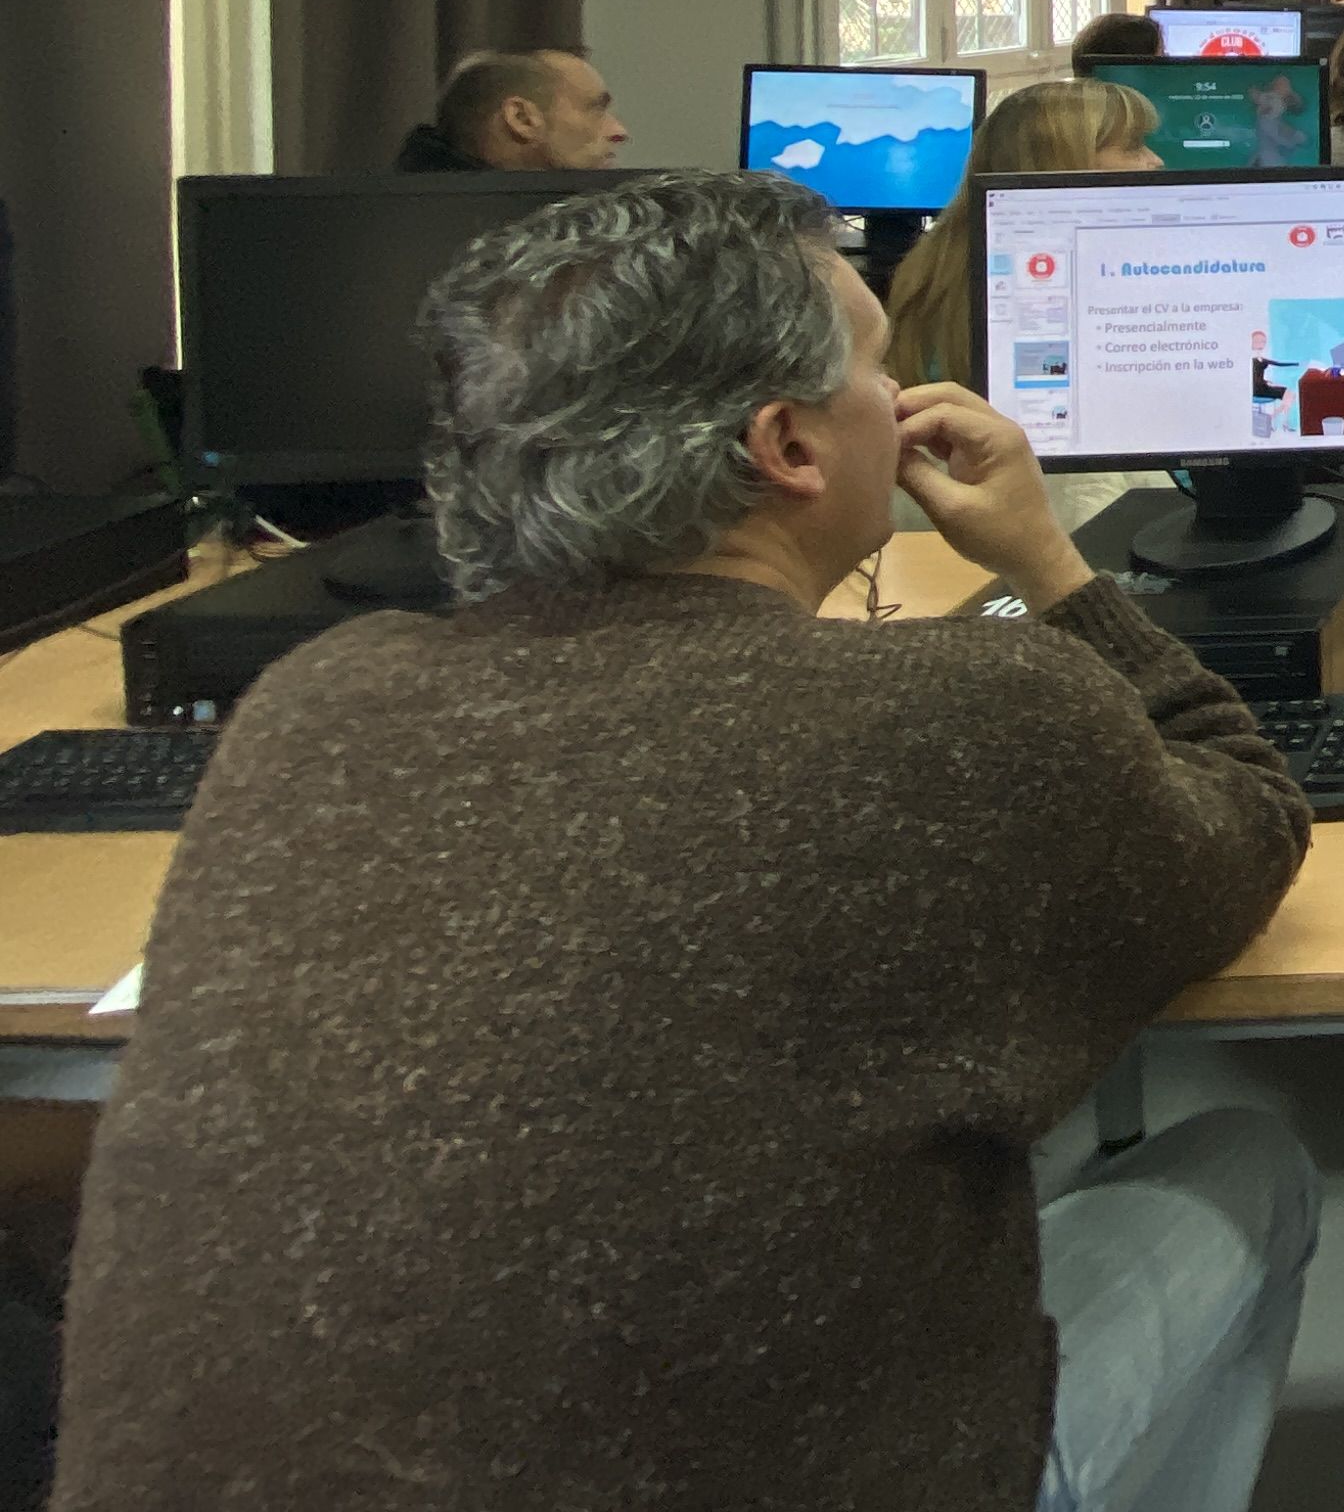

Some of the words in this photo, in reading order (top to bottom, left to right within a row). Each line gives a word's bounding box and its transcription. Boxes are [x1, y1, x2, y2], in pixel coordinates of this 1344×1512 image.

[1220, 36, 1244, 48] CLUB
[1121, 260, 1266, 277] Autocandidatura
[1088, 304, 1138, 315] Presentar
[1193, 303, 1243, 314] empresa:
[1105, 321, 1206, 334] Presencialmente
[1105, 342, 1147, 353] Correo
[1150, 339, 1219, 352] electrónico
[1105, 360, 1171, 373] Inscripción
[1208, 358, 1234, 369] web
